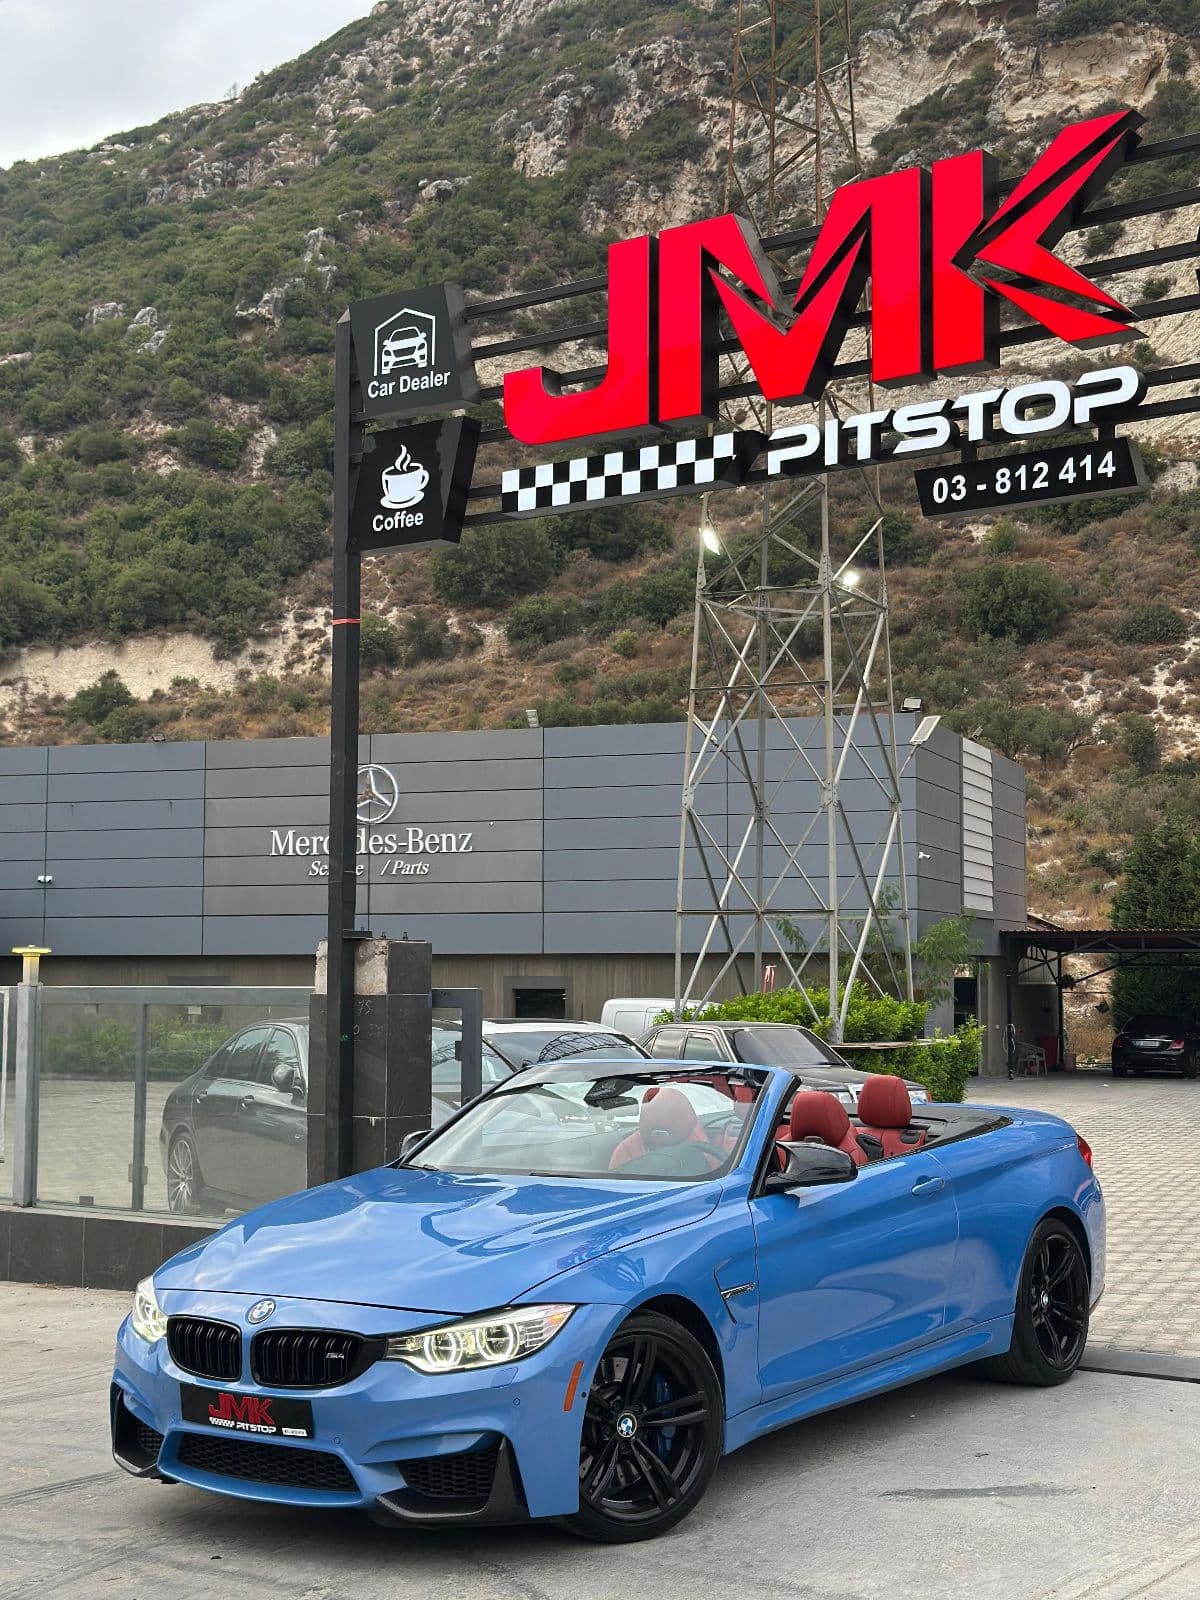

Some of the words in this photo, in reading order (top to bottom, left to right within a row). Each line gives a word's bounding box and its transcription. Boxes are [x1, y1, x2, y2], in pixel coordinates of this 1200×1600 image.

[503, 109, 1146, 446] JMK
[367, 380, 396, 399] Car
[399, 370, 451, 393] Dealer
[767, 365, 1140, 476] PITSTOP
[932, 475, 967, 504] 03
[995, 461, 1049, 495] 812
[1058, 450, 1116, 484] 414
[372, 511, 424, 532] Coffee
[269, 827, 473, 857] Merdes-Benz
[208, 1392, 275, 1425] JMK
[236, 1420, 277, 1434] PITSTOP
